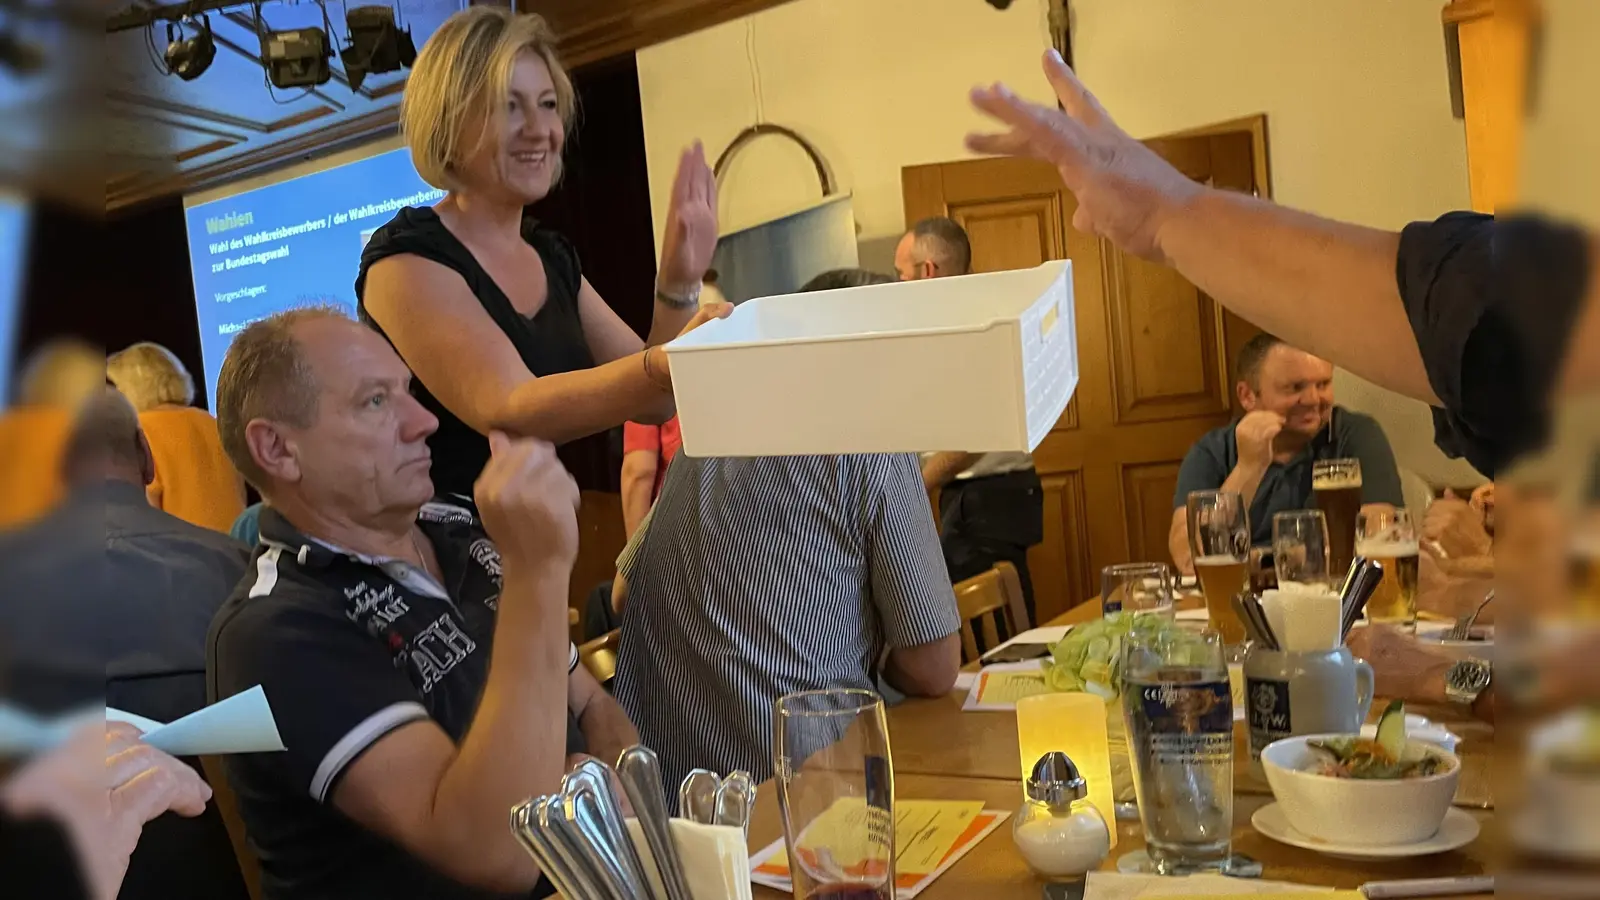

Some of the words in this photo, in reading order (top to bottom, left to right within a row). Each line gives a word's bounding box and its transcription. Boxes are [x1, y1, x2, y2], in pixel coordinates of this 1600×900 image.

[206, 211, 253, 234] Wahlen
[209, 240, 228, 254] Wahl
[230, 238, 243, 250] des
[244, 219, 326, 246] Wahlkreisbewerbers
[334, 211, 348, 225] der
[349, 189, 443, 220] Wahlkreisbewerberin
[212, 262, 224, 273] zur
[225, 244, 289, 270] Bundestagswahl
